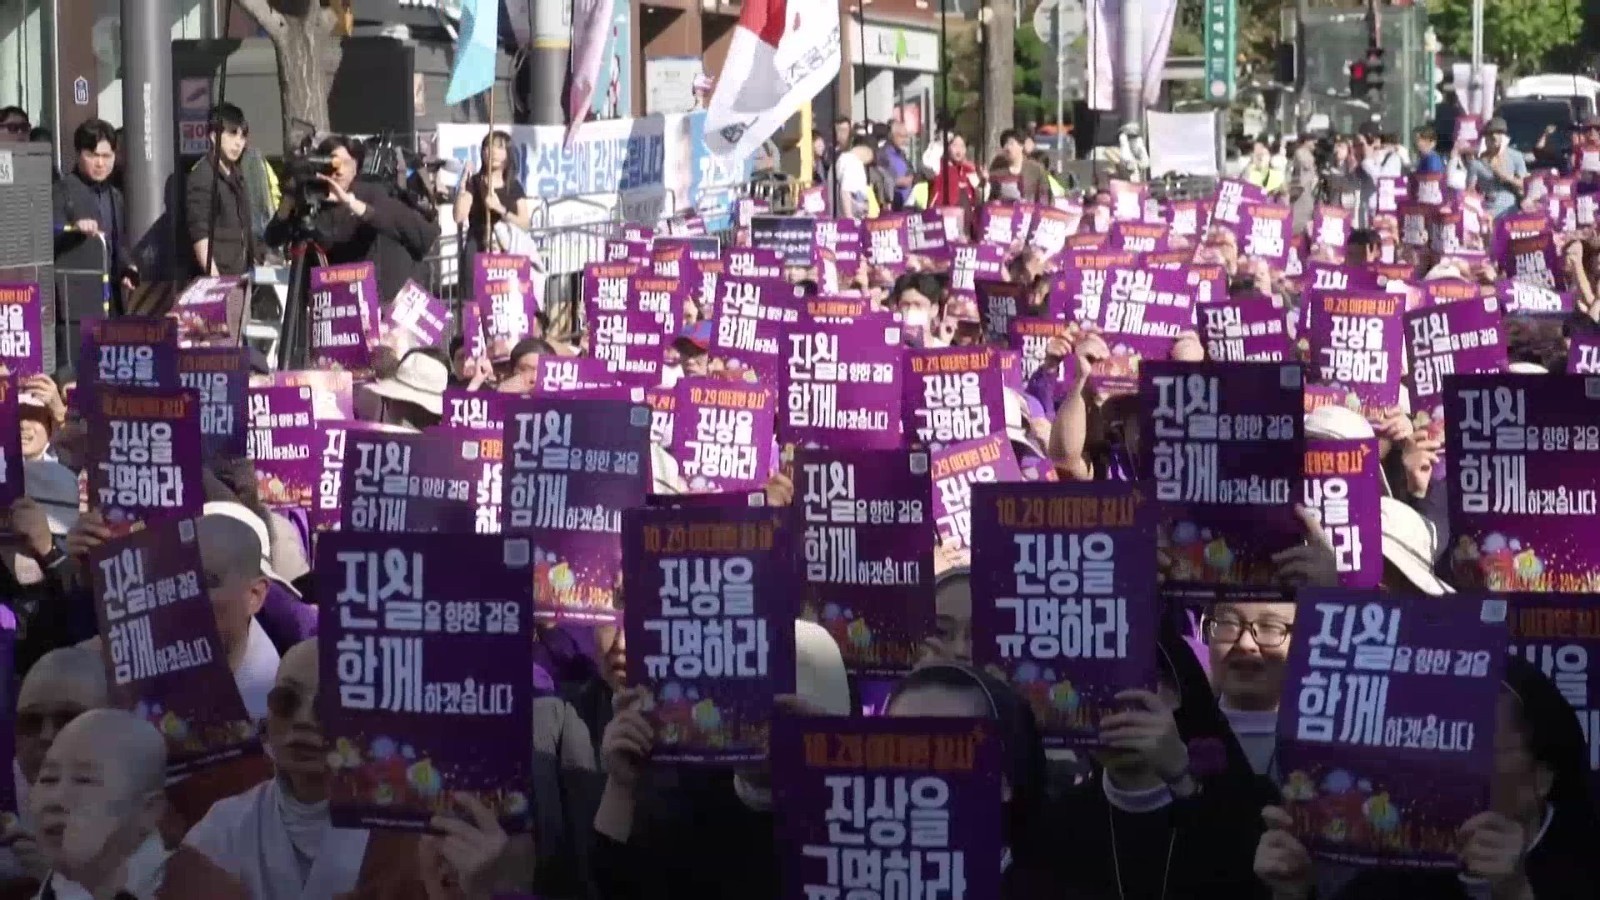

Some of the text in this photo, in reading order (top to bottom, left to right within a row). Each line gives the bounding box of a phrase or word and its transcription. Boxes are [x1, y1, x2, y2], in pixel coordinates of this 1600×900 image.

[788, 332, 893, 383] 진실을 향한 걸음
[1330, 316, 1384, 350] 진상을
[912, 356, 939, 372] 10.29
[923, 372, 982, 408] 진상을
[1320, 348, 1389, 384] 규명하라
[248, 394, 278, 428] 실을
[691, 388, 717, 405] 10.29
[697, 407, 754, 444] 진상을
[788, 383, 889, 430] 함께하겠습니다
[914, 404, 991, 441] 규명하라
[1152, 373, 1232, 440] 진실을
[1458, 385, 1600, 451] 진실을 향한 걸음
[109, 420, 173, 464] 진상을
[354, 441, 420, 494] 진실을
[513, 410, 582, 470] 진실을
[683, 441, 758, 480] 규명하라
[98, 463, 184, 507] 규명하라
[803, 461, 923, 524] 진실을 향한 걸음
[1153, 442, 1290, 504] 함께하겠습니다
[1459, 453, 1598, 515] 함께하겠습니다
[996, 496, 1044, 527] 10.29
[99, 548, 156, 620] 진실을
[804, 525, 920, 585] 함께하겠습니다
[1013, 533, 1114, 595] 진상을
[336, 548, 521, 633] 진실을 향한 걸음
[659, 556, 754, 617] 진상을
[109, 617, 214, 685] 함께하겠습니다
[644, 618, 769, 679] 규명하라
[995, 598, 1129, 659] 규명하라
[1308, 602, 1413, 674] 진실을
[1415, 647, 1451, 675] 향한
[1454, 649, 1490, 677] 걸음
[336, 634, 514, 715] 함께하겠습니다
[1297, 671, 1475, 751] 함께하겠습니다
[824, 775, 949, 847] 진상을
[802, 845, 967, 900] 규명하라
